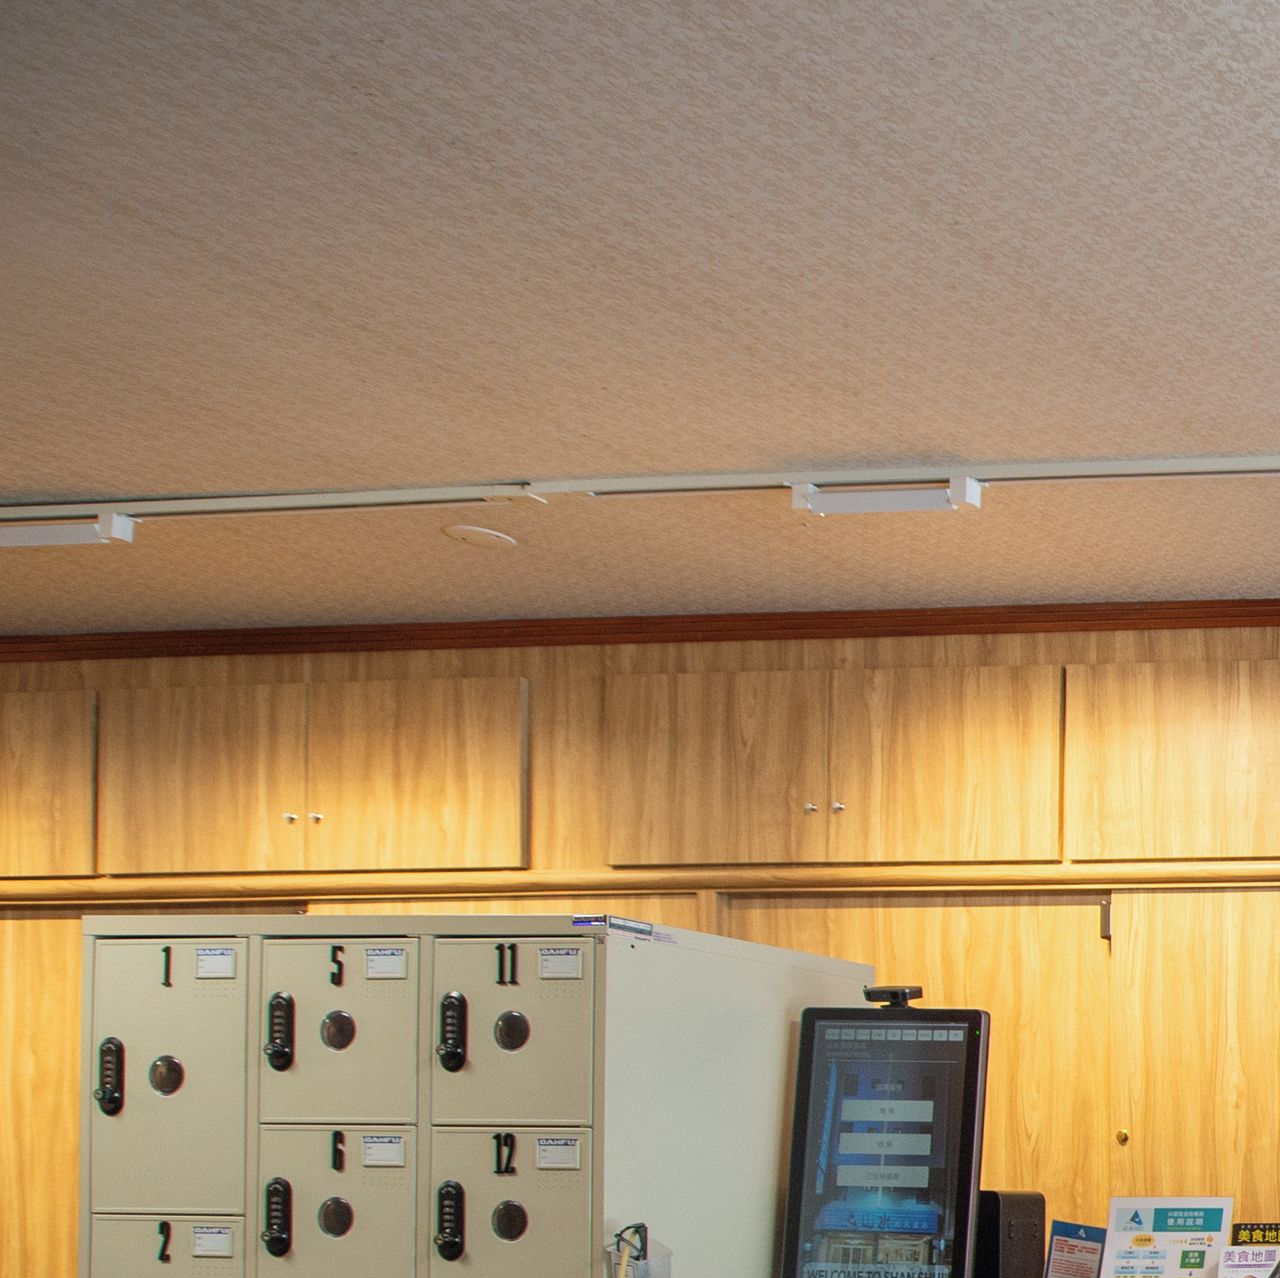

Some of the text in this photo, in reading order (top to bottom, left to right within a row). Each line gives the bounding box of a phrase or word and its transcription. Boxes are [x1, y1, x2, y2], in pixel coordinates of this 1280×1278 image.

[161, 946, 173, 987] 1
[330, 946, 345, 986] 5
[496, 943, 519, 985] 11
[332, 1130, 345, 1172] 6
[493, 1133, 517, 1175] 12
[158, 1221, 171, 1263] 2
[1223, 1250, 1277, 1263] 美食地圖
